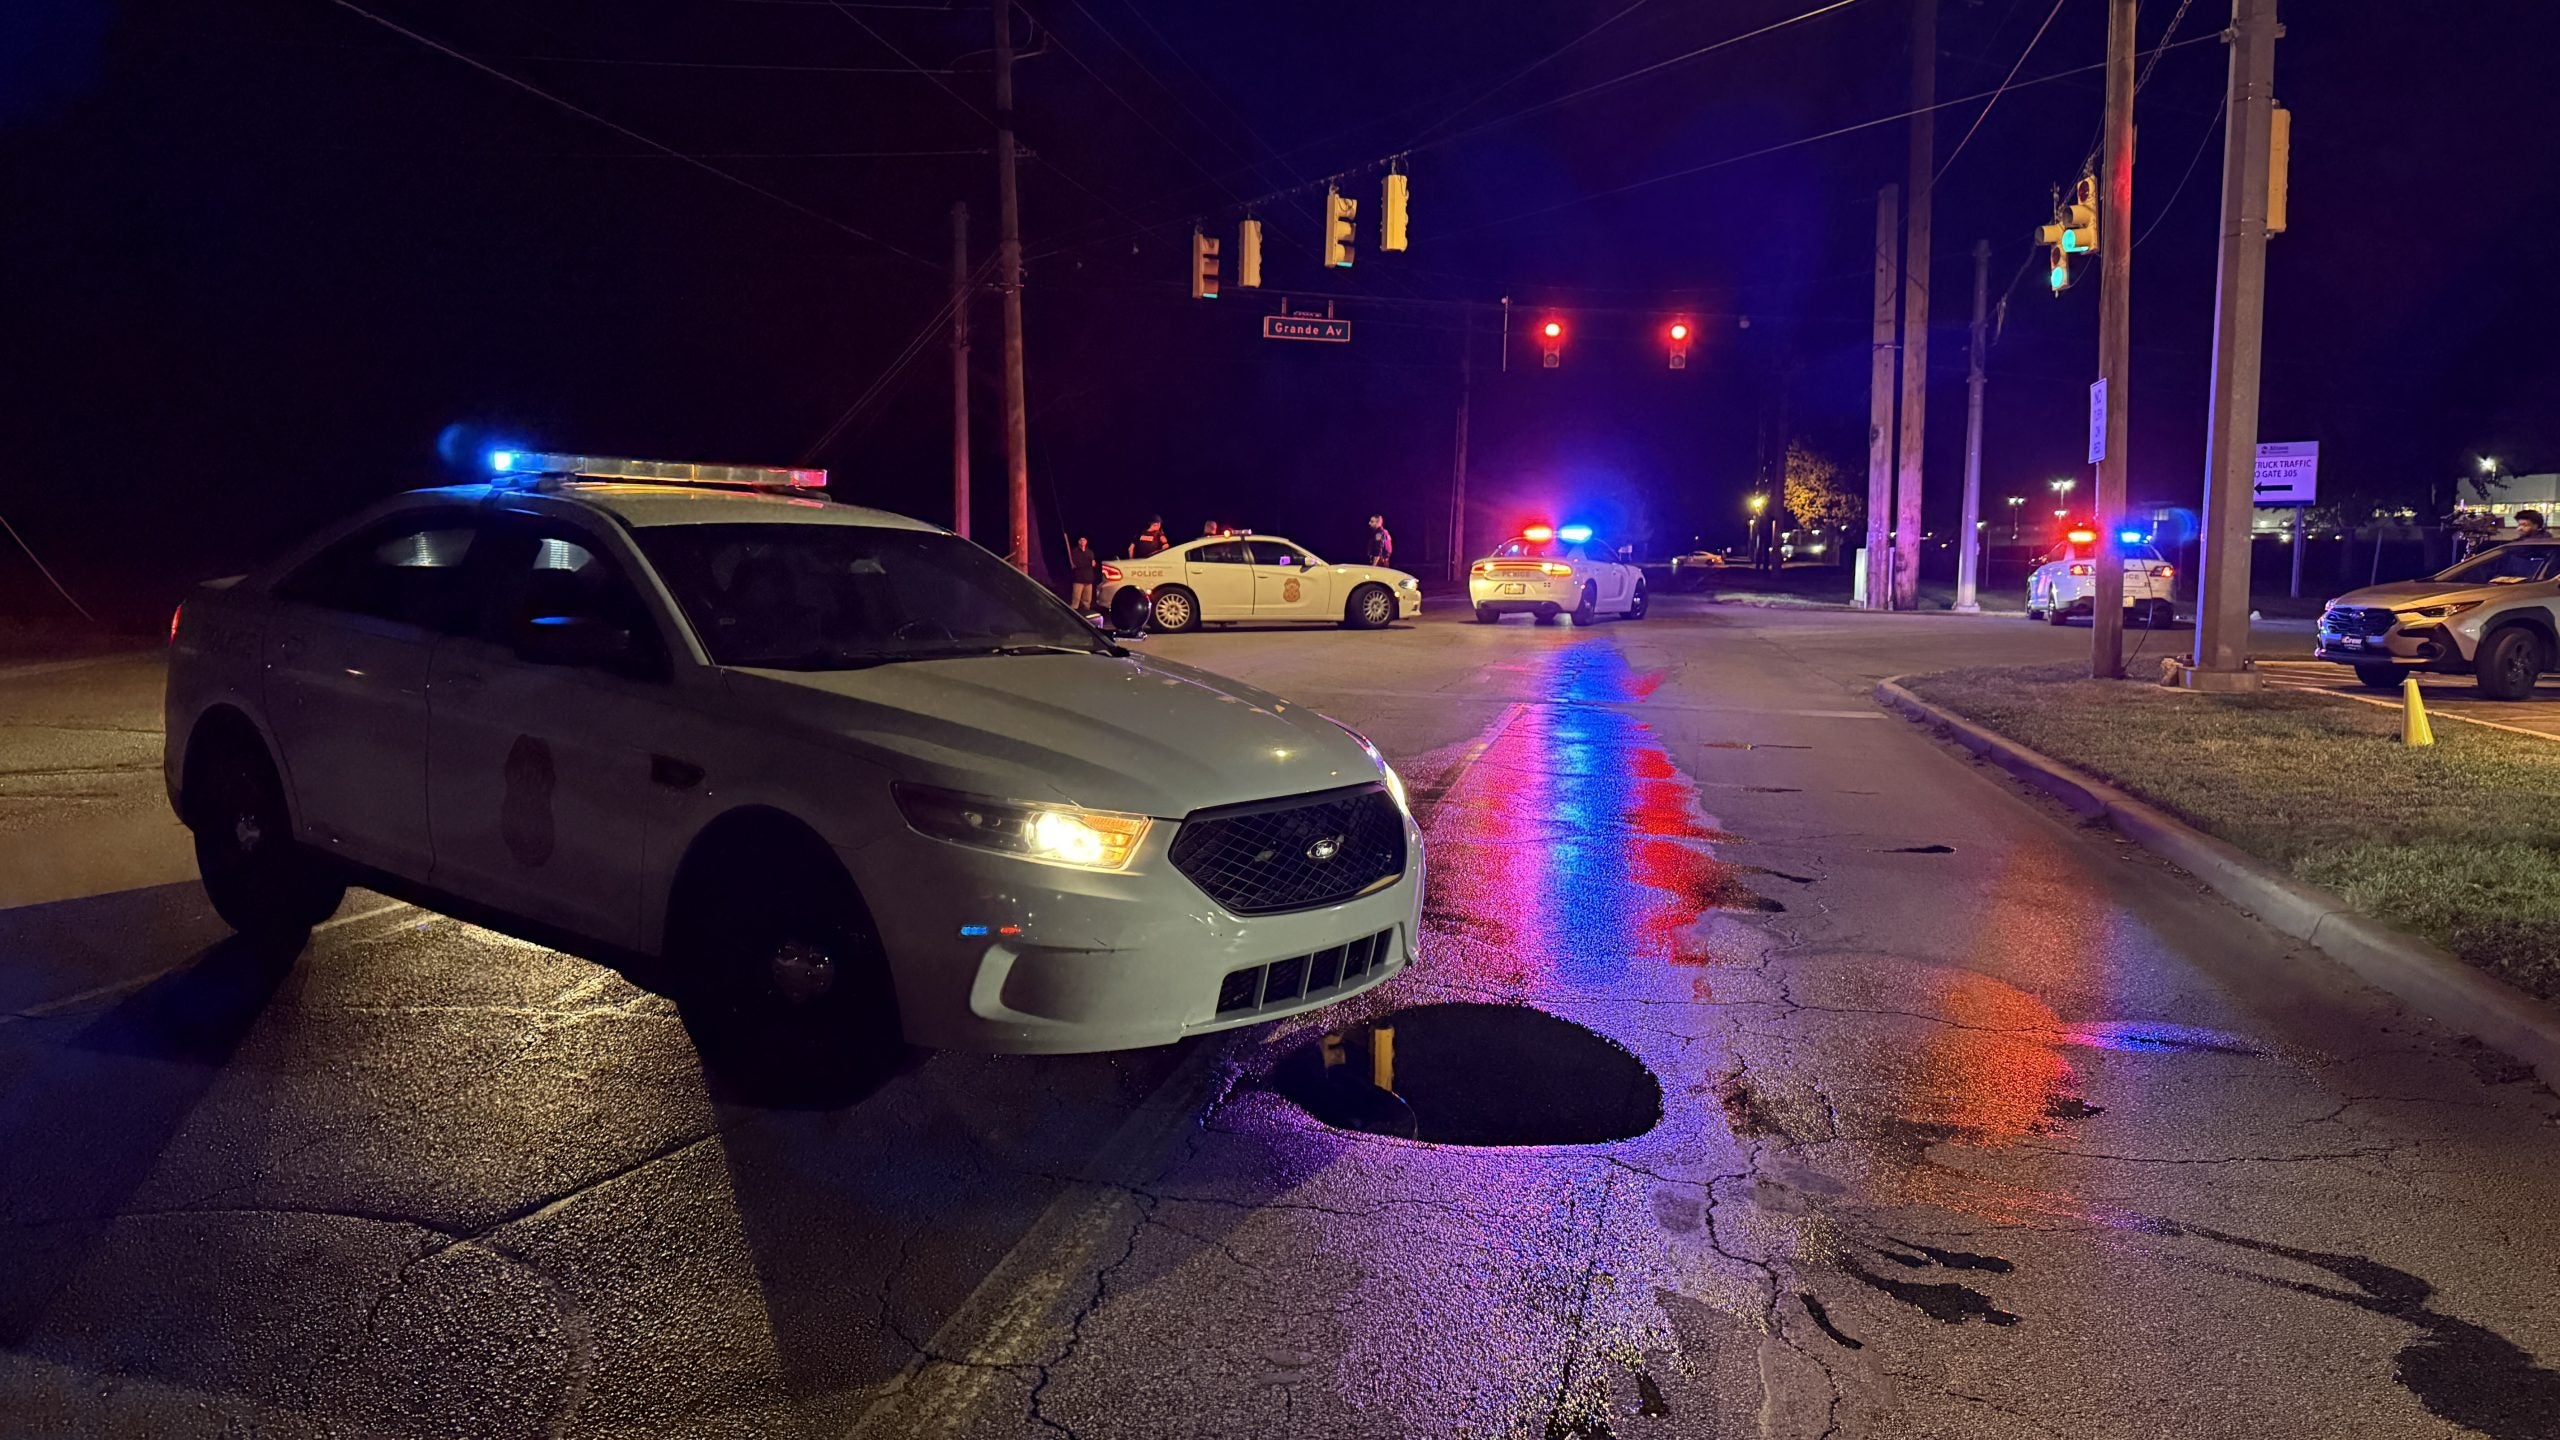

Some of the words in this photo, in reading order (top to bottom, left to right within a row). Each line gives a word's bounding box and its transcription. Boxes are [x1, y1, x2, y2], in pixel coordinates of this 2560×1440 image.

[1274, 322, 1319, 335] Grande
[1325, 325, 1342, 336] Av
[2280, 459, 2311, 468] TRAFFIC
[2255, 470, 2261, 478] O
[2262, 470, 2281, 478] GATE
[2283, 470, 2298, 478] 305
